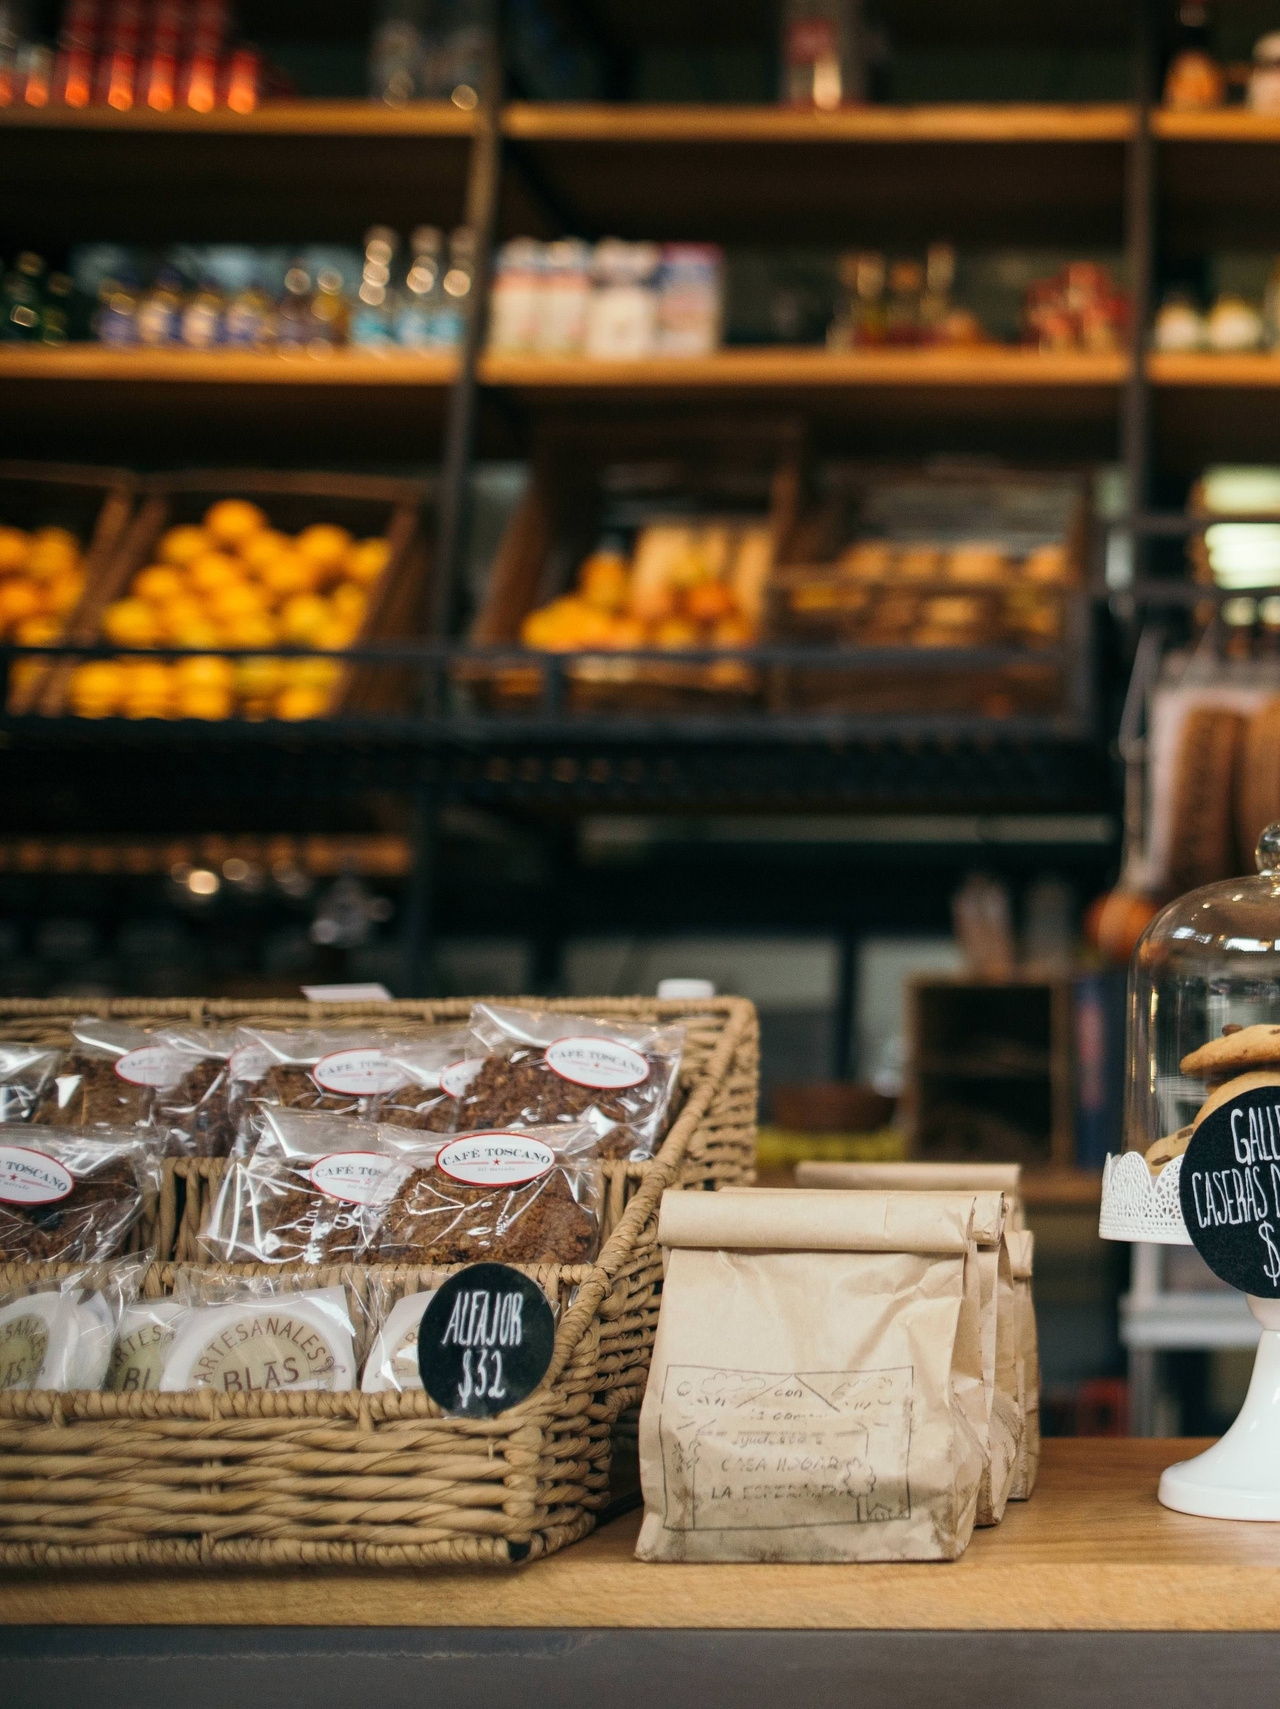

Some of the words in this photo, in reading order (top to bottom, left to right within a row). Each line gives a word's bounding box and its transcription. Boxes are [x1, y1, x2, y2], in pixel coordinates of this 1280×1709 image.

[315, 1164, 354, 1178] CAFÉ
[442, 1147, 480, 1166] CAFÉ
[484, 1147, 551, 1165] TOSCANO
[5, 1160, 68, 1192] TOSCANO
[1191, 1164, 1269, 1229] CASERAS
[440, 1290, 524, 1347] ALFAJOR
[193, 1317, 326, 1384] ARTESANALES
[457, 1349, 507, 1409] $32
[774, 1389, 803, 1399] con
[711, 1486, 732, 1499] LA
